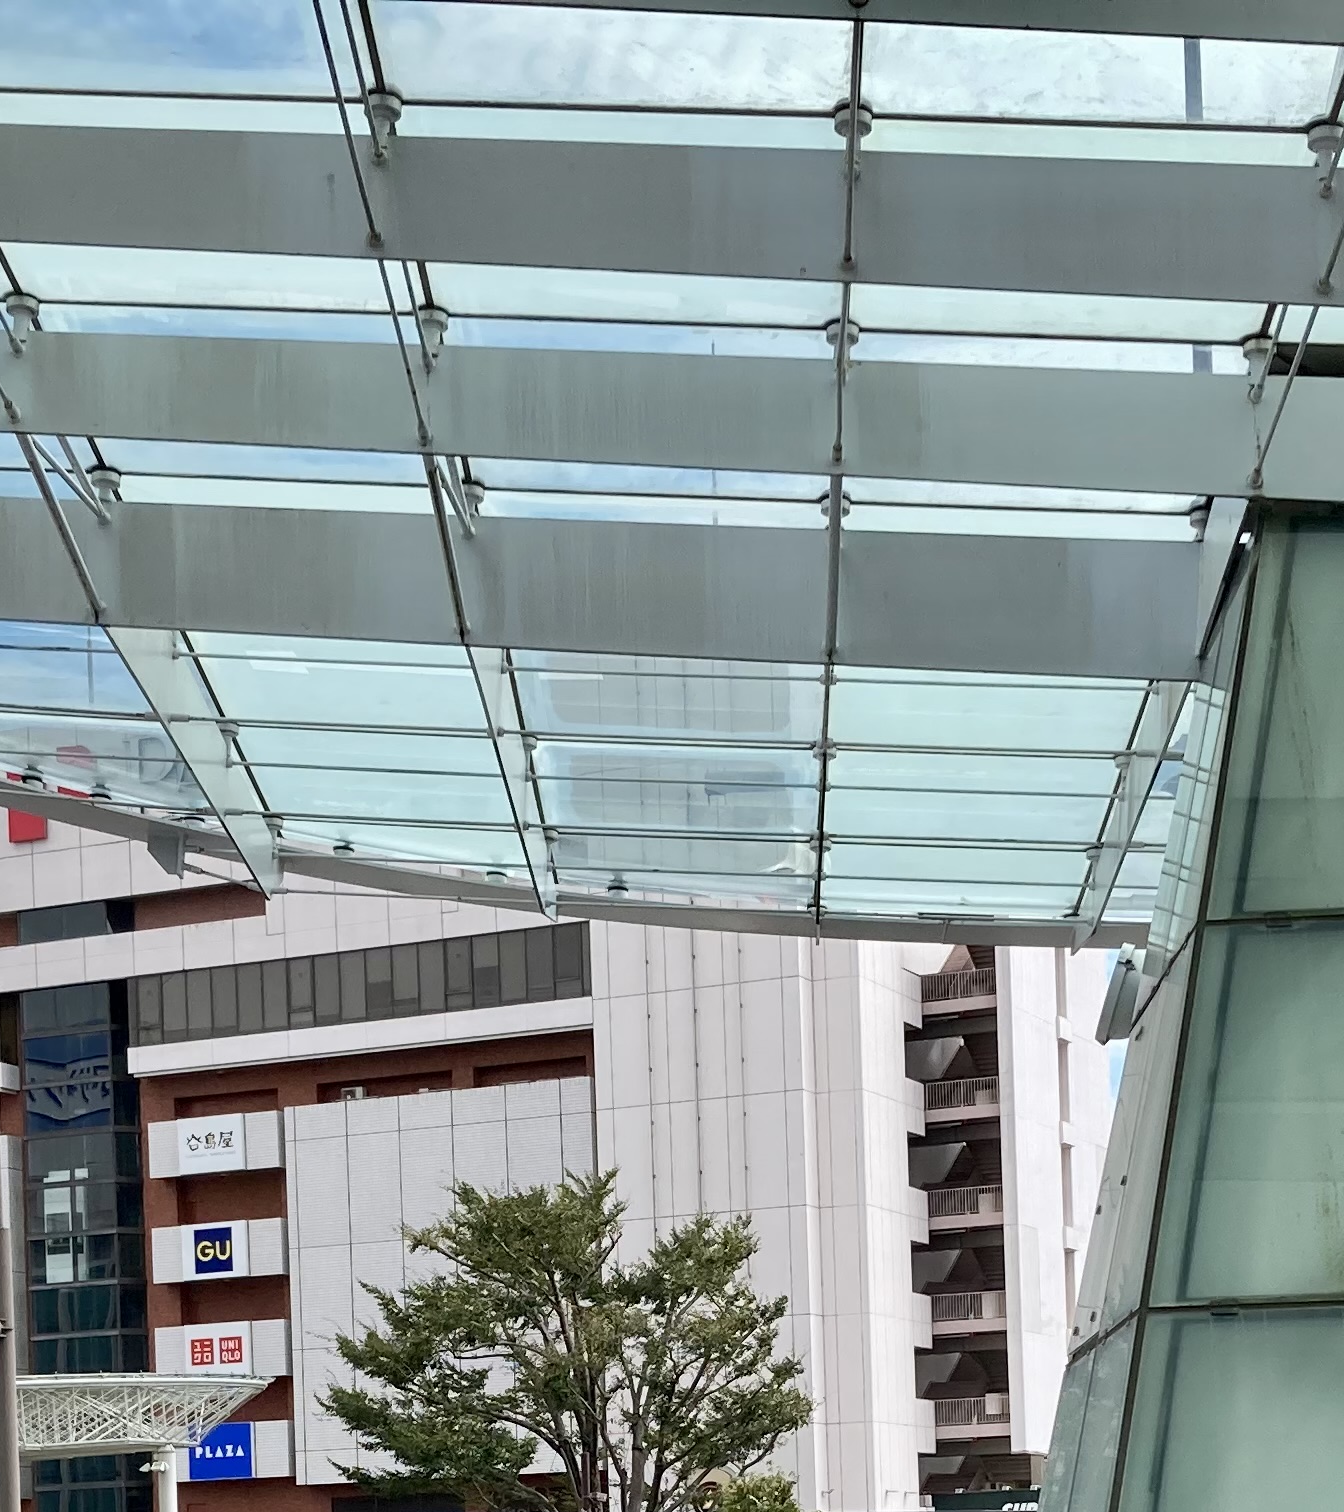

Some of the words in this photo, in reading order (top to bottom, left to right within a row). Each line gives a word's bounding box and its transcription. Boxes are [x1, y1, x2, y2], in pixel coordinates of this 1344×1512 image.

[186, 1131, 234, 1151] 谷島屋
[197, 1241, 230, 1261] GU
[195, 1445, 244, 1458] PLAZA
